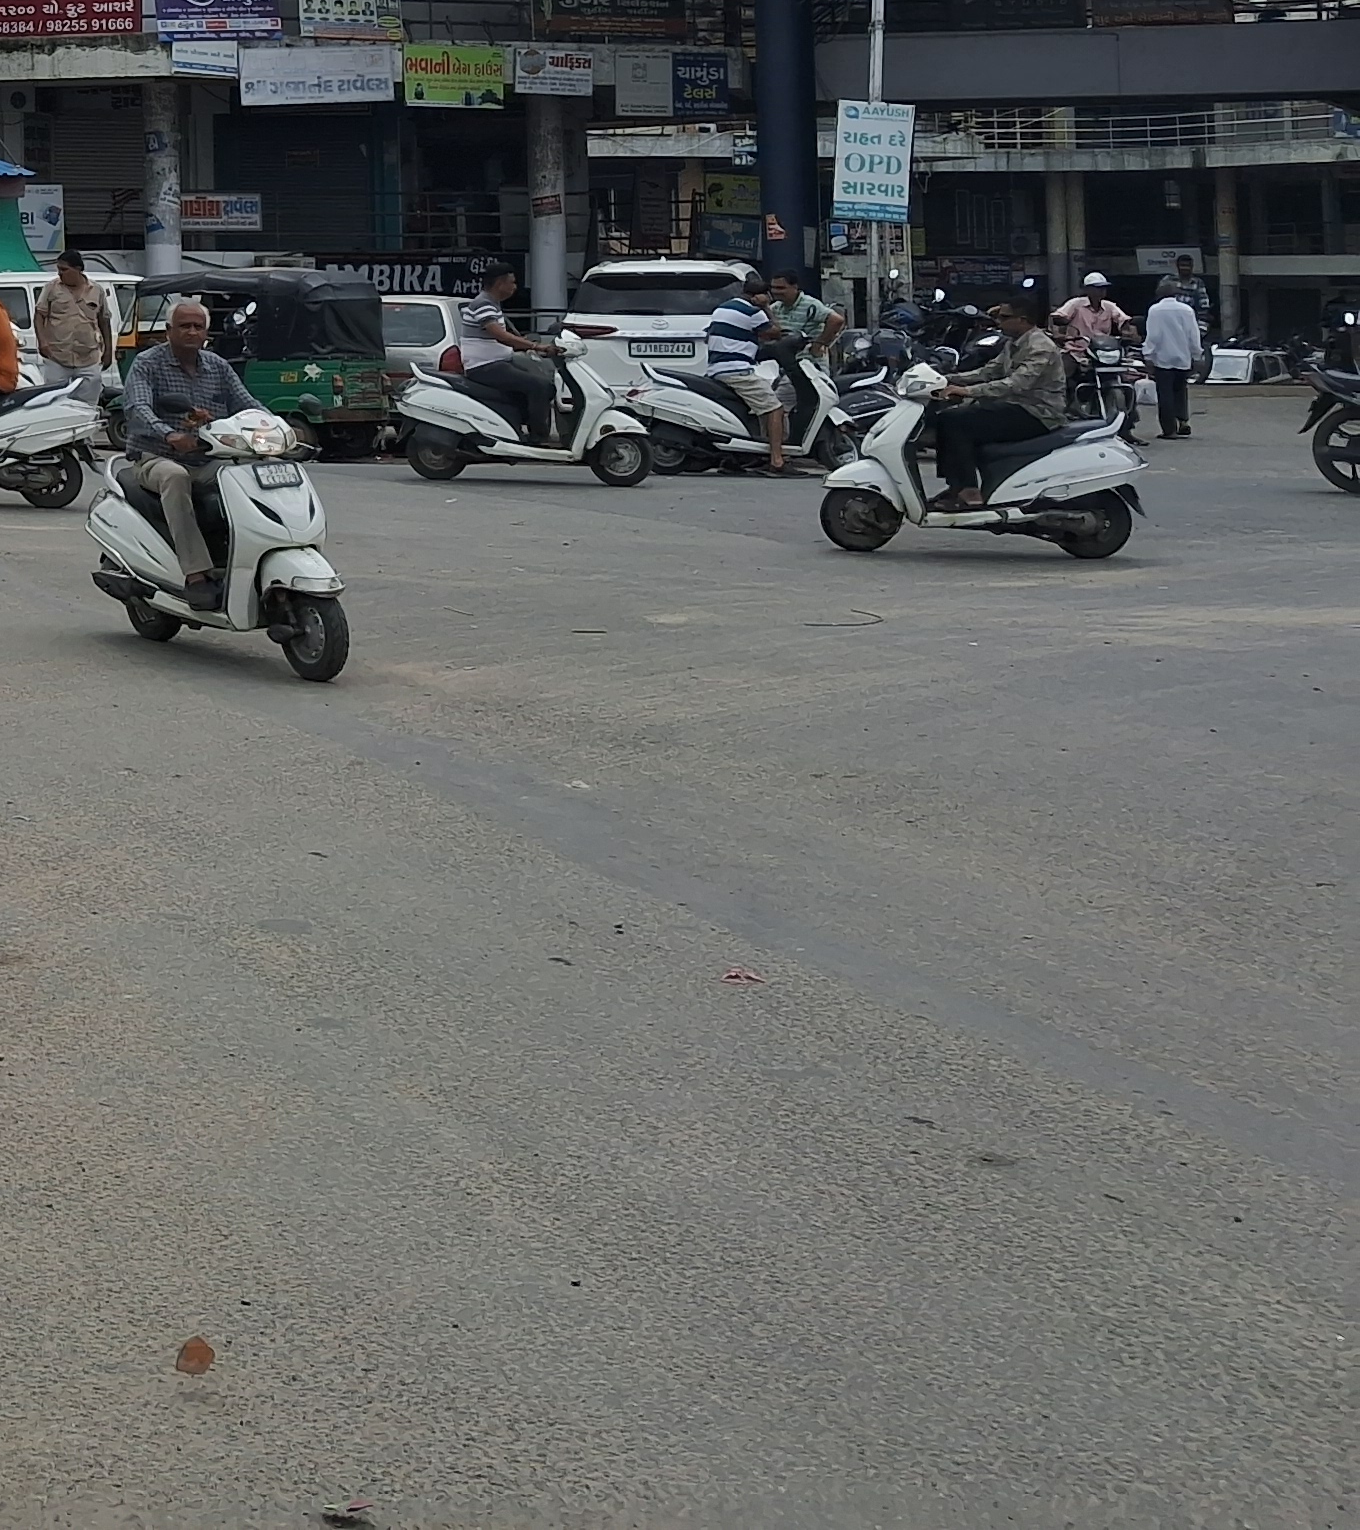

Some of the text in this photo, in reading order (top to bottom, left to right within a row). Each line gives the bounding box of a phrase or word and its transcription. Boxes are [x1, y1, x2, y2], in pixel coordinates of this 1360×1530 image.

[46, 19, 87, 32] 98255
[92, 18, 133, 31] 91666
[405, 51, 503, 77] ભવાની બેગ હાઉસ
[676, 63, 724, 85] ચામુંડા
[683, 84, 718, 99] ટેલર્સ
[862, 106, 909, 118] AAYUSH
[843, 130, 907, 147] રાહત દરે
[844, 152, 903, 175] OPD
[841, 180, 906, 198] સારવાર
